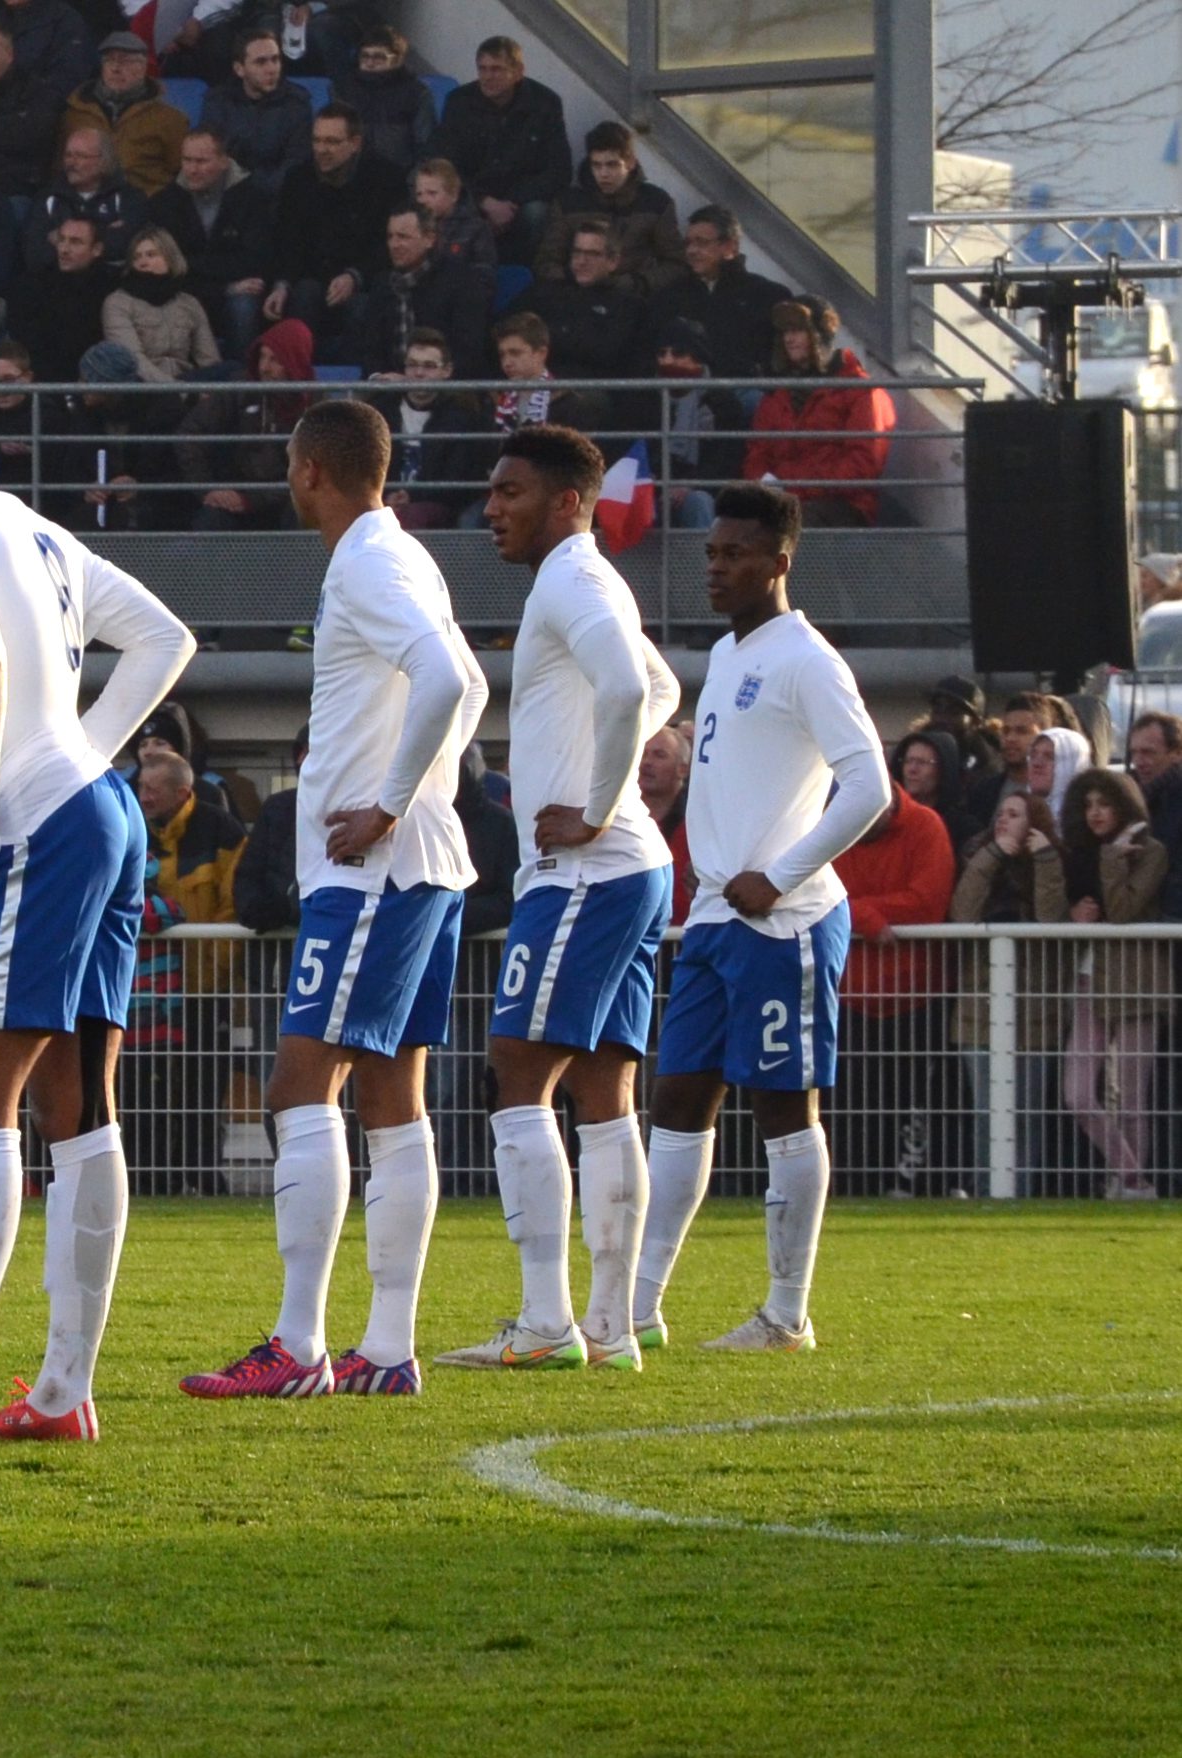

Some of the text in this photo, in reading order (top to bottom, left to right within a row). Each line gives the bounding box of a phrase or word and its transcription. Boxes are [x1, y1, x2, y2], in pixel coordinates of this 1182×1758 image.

[698, 712, 717, 764] 2
[296, 937, 331, 996] 5
[502, 943, 531, 997] 6
[761, 1000, 789, 1052] 2
